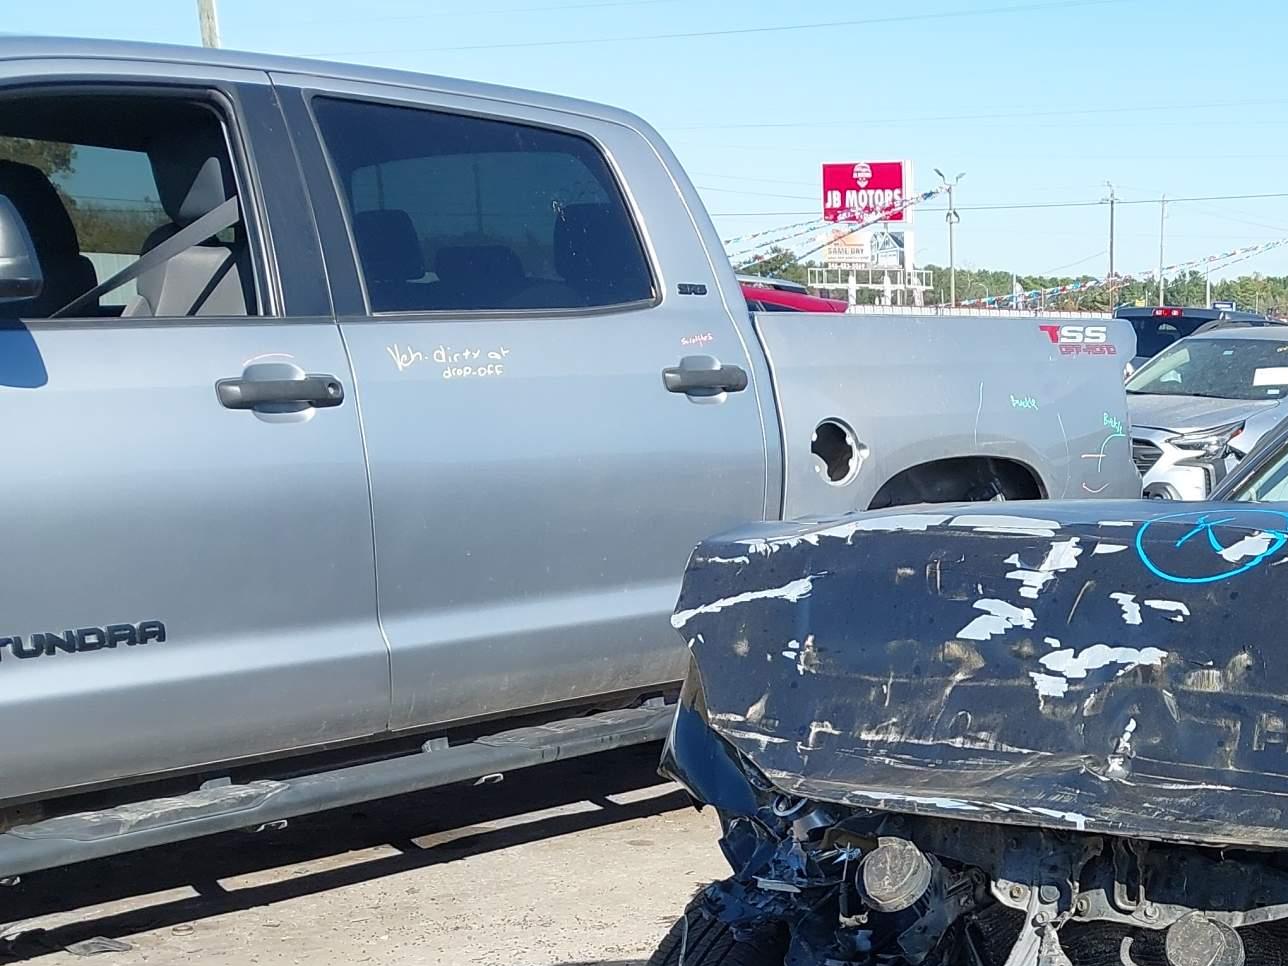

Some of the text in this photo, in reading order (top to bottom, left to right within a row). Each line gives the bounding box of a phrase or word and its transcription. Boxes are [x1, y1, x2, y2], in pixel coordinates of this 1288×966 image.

[825, 188, 901, 208] JB MOTORS
[1039, 325, 1107, 343] TSS
[433, 345, 481, 363] dirty
